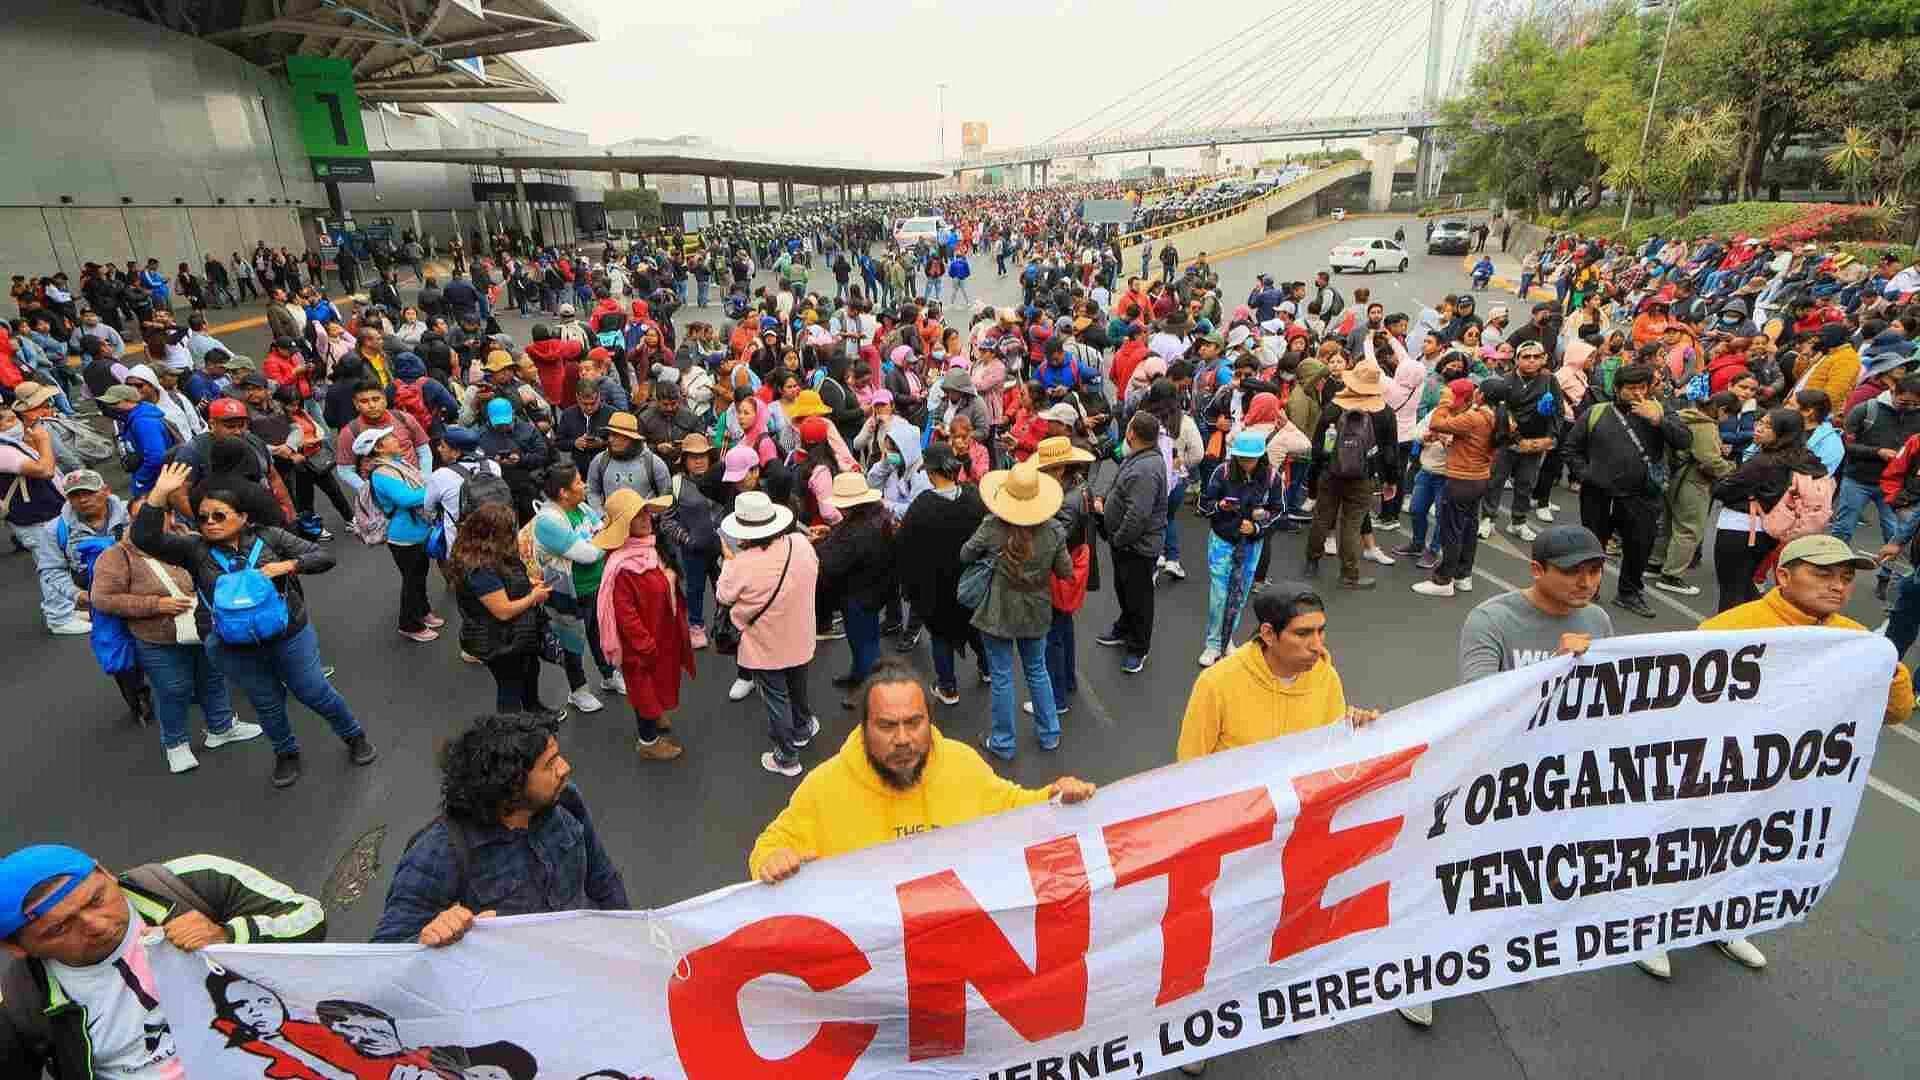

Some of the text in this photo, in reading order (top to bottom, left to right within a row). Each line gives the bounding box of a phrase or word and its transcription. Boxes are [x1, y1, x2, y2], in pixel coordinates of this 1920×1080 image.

[313, 91, 349, 146] 1
[1427, 721, 1861, 839] Y ORGANIZADOS,
[667, 743, 1430, 1080] CNTE
[1436, 807, 1832, 915] VENCEREMOS!!
[1159, 1000, 1244, 1056] LOS
[1257, 944, 1491, 1030] DERECHOS
[1506, 930, 1561, 973] SE
[1575, 886, 1821, 962] DEFIENDEN!
